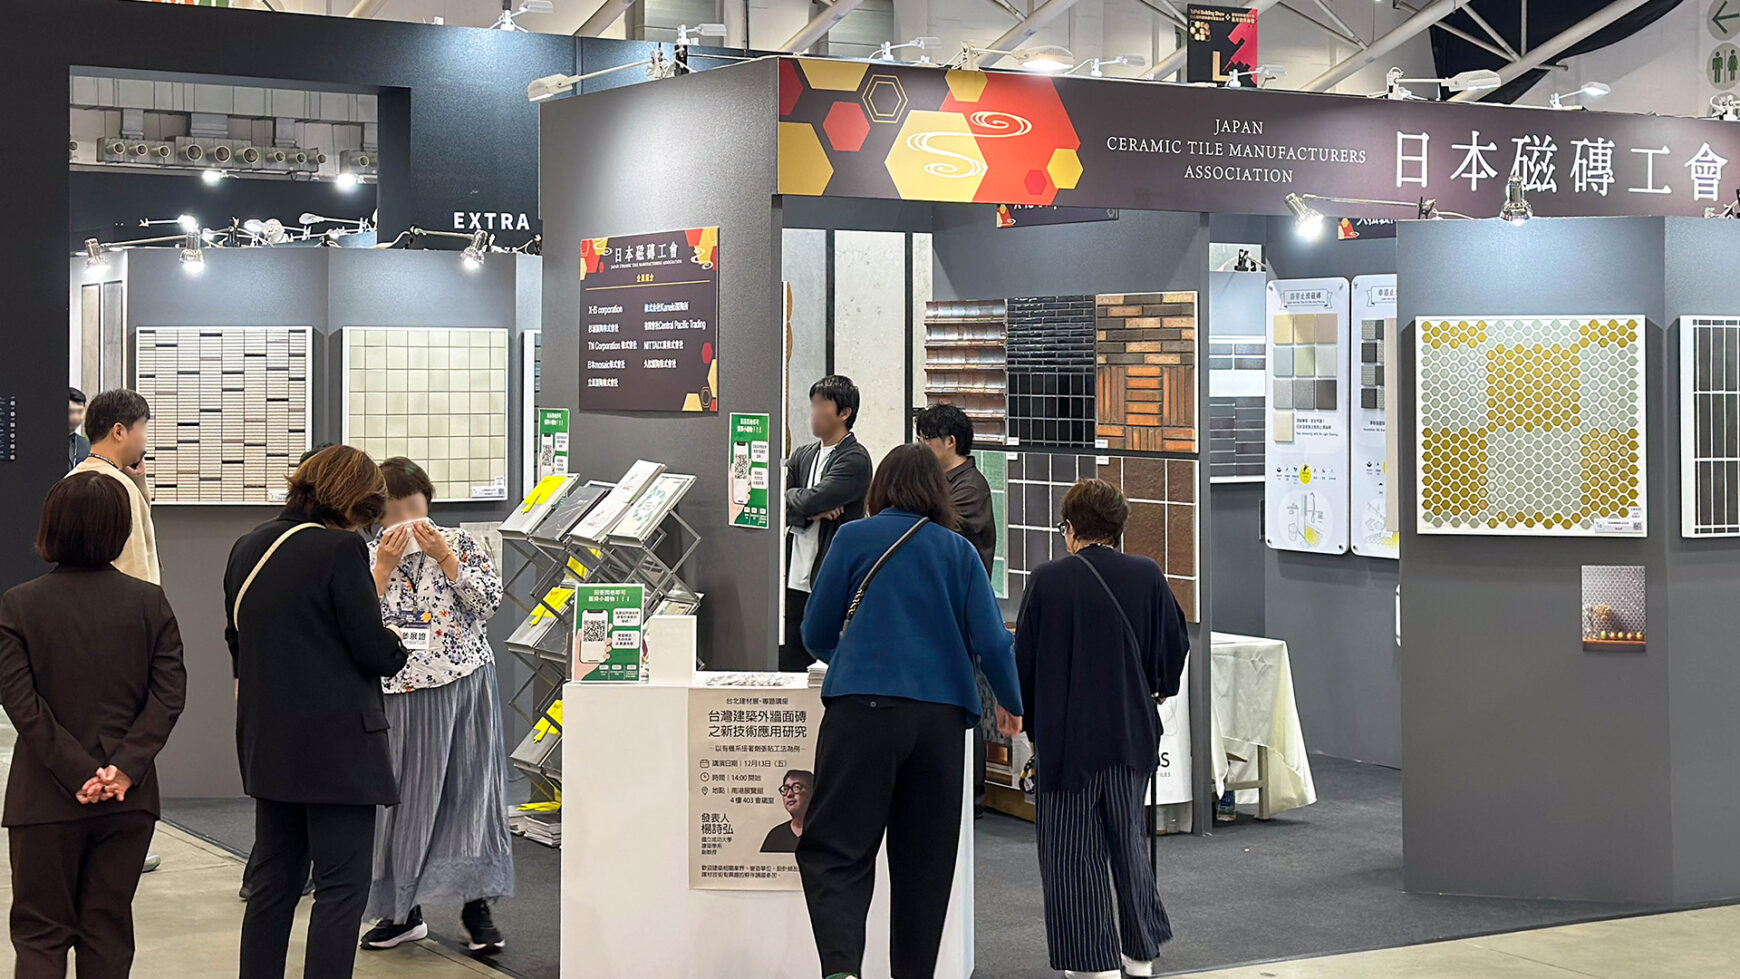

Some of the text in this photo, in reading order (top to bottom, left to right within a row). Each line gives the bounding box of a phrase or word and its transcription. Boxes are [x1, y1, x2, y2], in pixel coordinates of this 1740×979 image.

[1214, 119, 1263, 135] JAPAN
[1107, 136, 1366, 164] CERAMIC TILE MANUFACTURERS
[1184, 165, 1293, 183] ASSOCIATION
[1396, 130, 1728, 202] 日本磁磚工會
[454, 212, 530, 230] EXTRA
[709, 710, 806, 723] 台灣建築外牆面磚
[709, 725, 807, 738] 之新技術應用研究
[701, 813, 729, 823] 發表人
